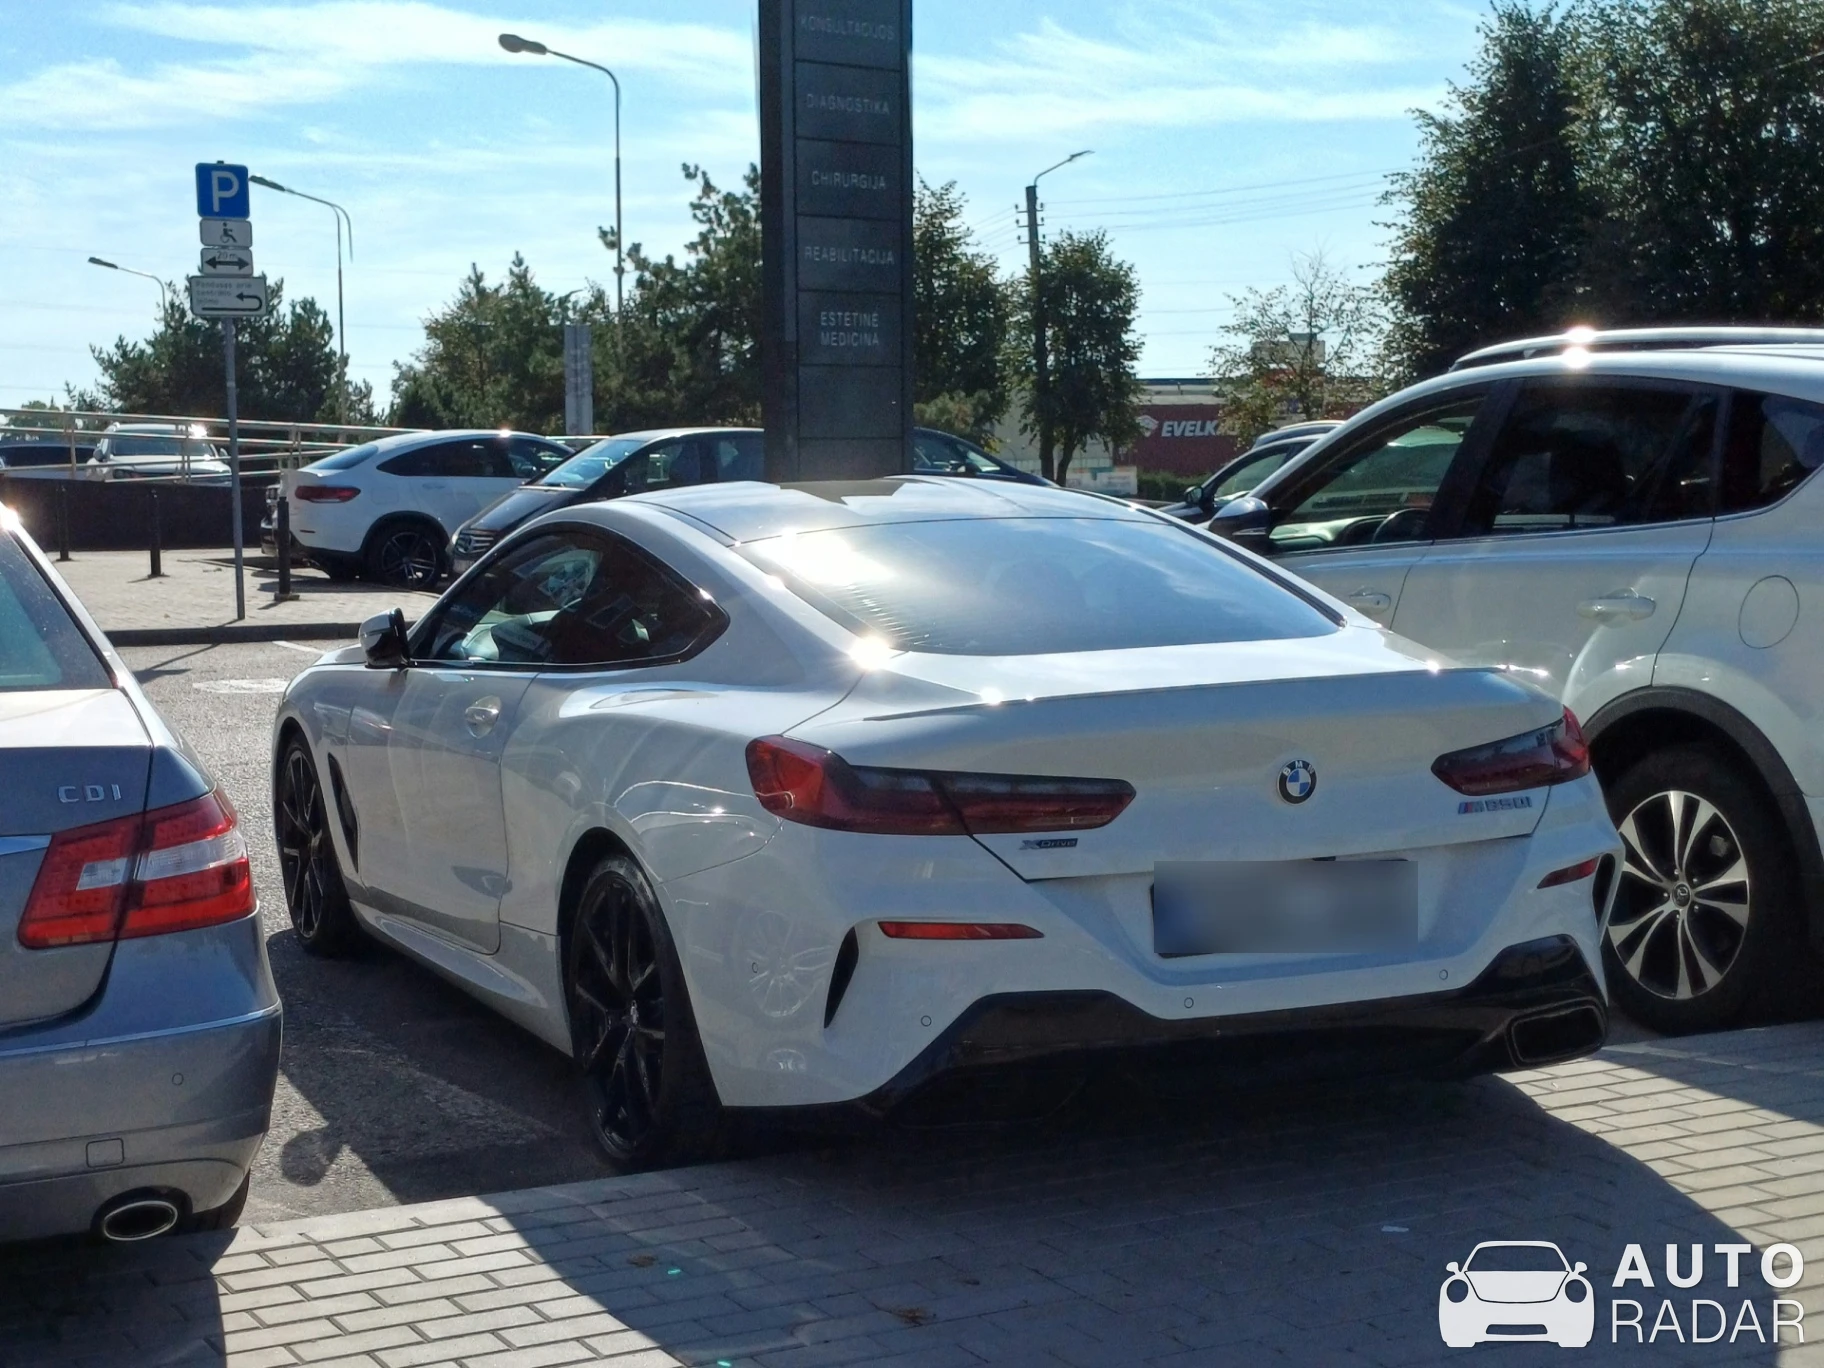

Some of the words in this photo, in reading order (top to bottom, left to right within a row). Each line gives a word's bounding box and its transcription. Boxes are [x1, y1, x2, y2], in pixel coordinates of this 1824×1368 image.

[806, 93, 890, 115] DIAGNOSTIKA
[811, 170, 886, 190] CHIRURGIJA
[211, 170, 240, 212] P
[804, 246, 895, 265] REABILITACIJA
[820, 331, 880, 347] MEDICINA
[58, 784, 121, 803] CDI
